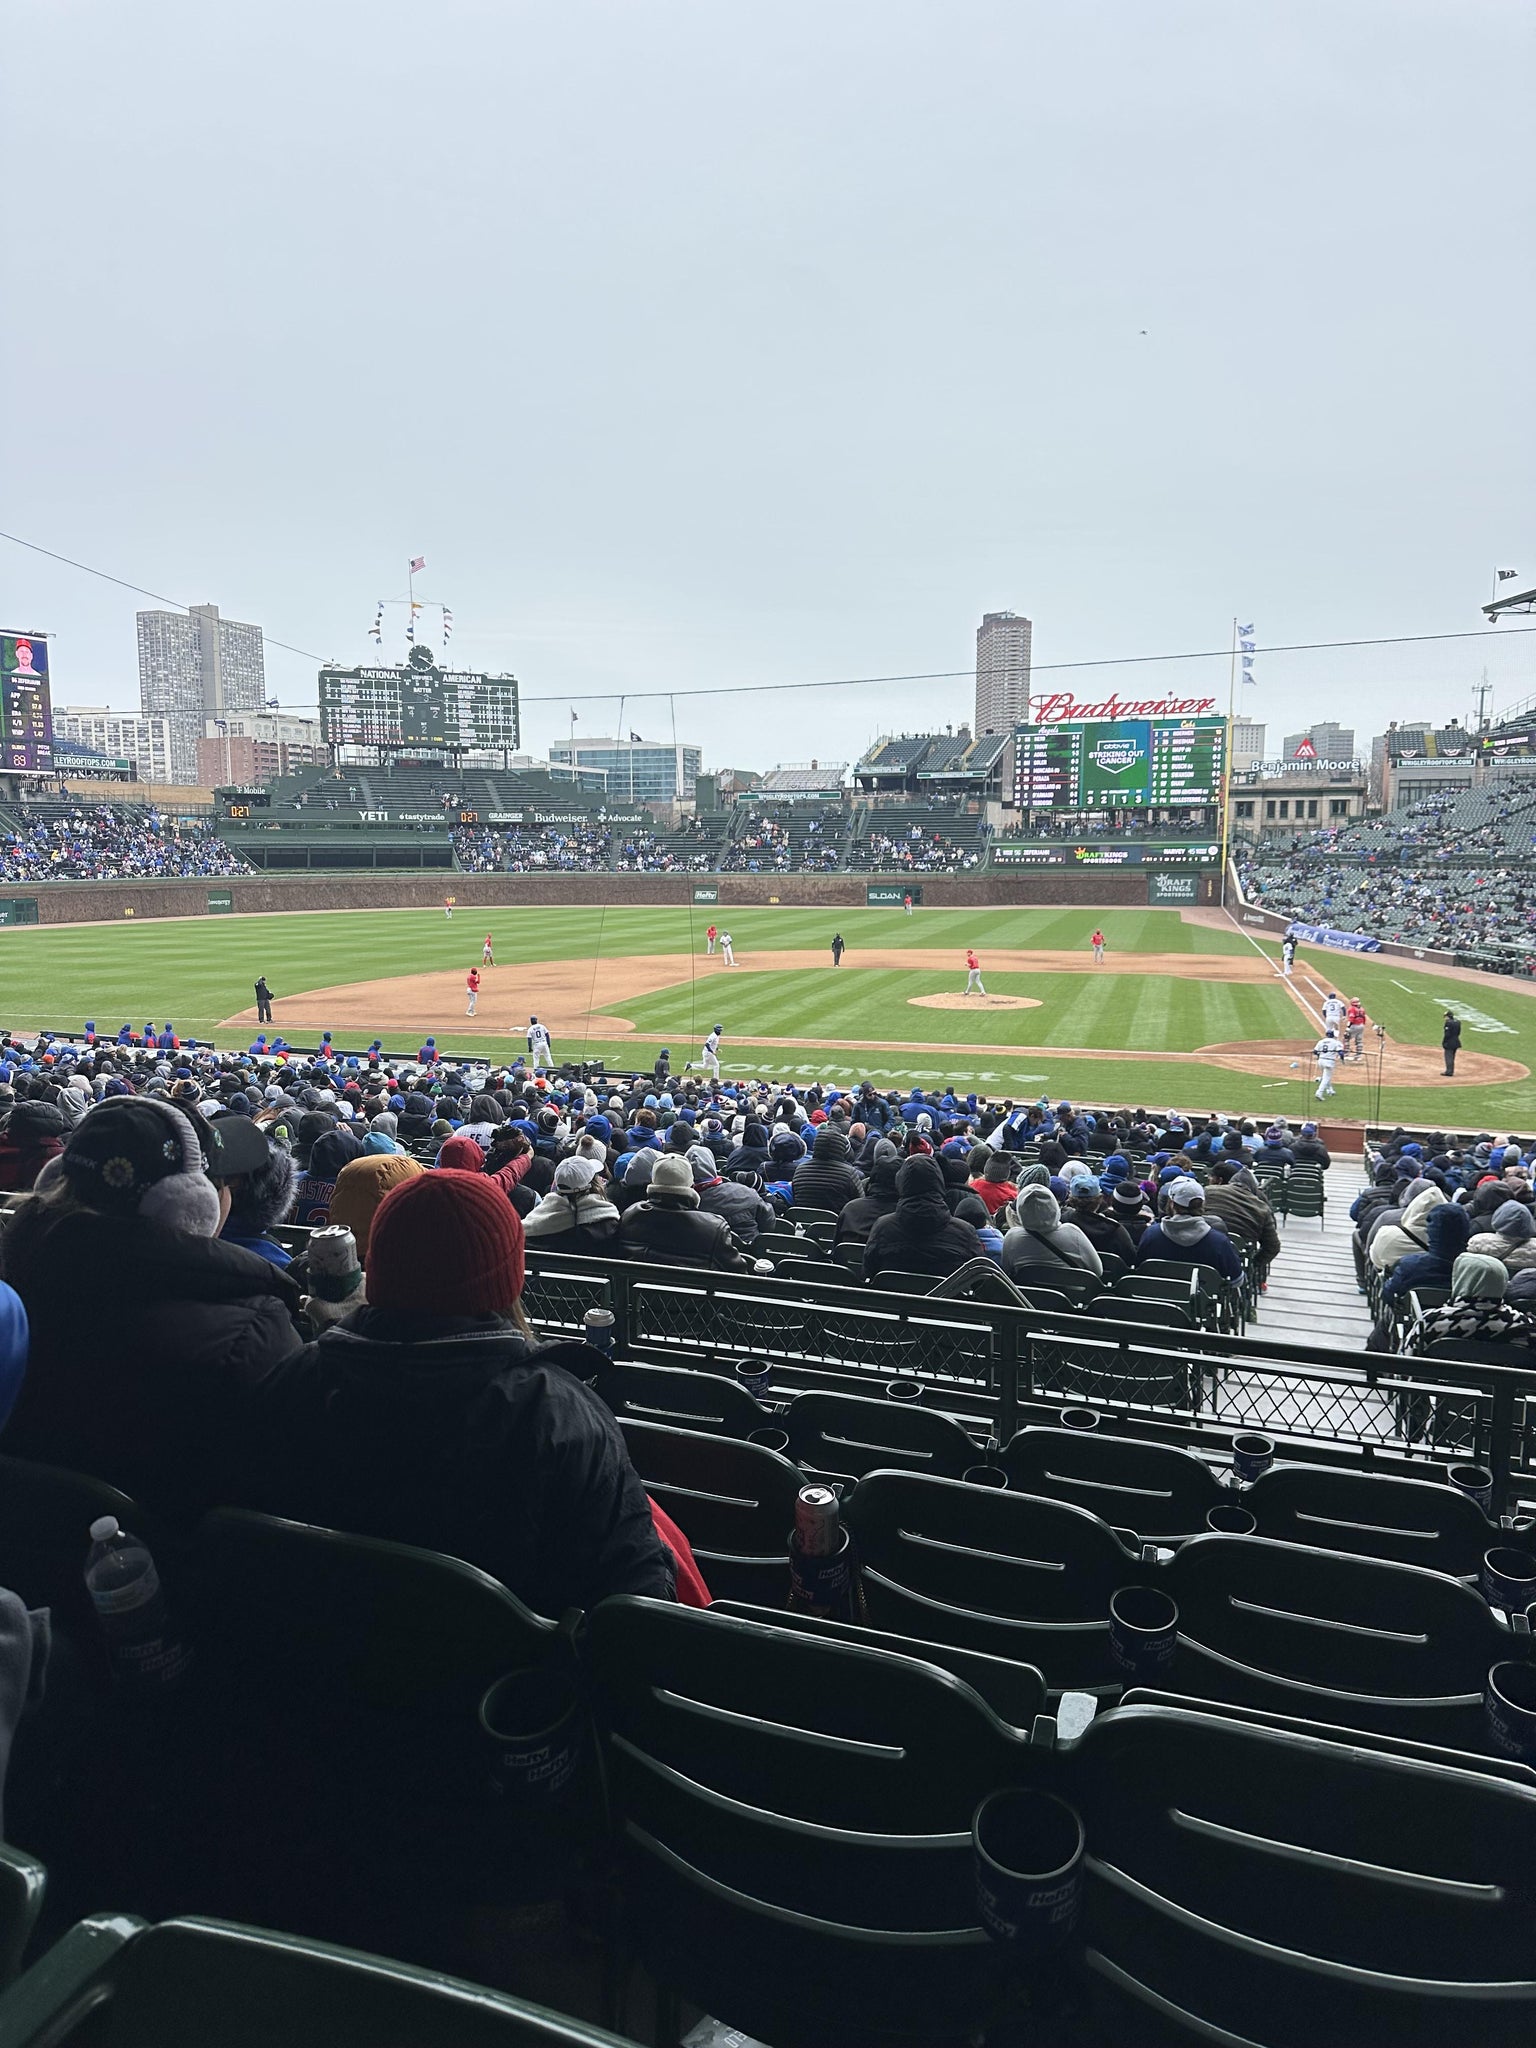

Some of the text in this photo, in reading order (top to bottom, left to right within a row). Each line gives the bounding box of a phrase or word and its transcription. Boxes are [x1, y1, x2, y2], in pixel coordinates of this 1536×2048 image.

[360, 670, 401, 680] NATIONAL
[442, 674, 482, 684] AMERICAN
[1028, 692, 1216, 723] Budweiser
[408, 710, 438, 718] 4 2
[1180, 720, 1196, 728] Cubs
[422, 726, 428, 734] 2
[1038, 726, 1058, 736] Angels
[1088, 750, 1144, 759] STRIKING OUT
[1251, 758, 1360, 773] Benjamin Moore
[244, 786, 266, 794] Mobile
[1087, 796, 1094, 804] 3
[1100, 795, 1108, 804] 2
[1135, 794, 1142, 804] 3
[231, 806, 250, 817] 0:27
[358, 812, 388, 821] YETI
[404, 813, 446, 821] tastytrade
[460, 812, 478, 822] 0:27
[1157, 879, 1192, 887] DRAFT
[696, 891, 717, 899] Hefty
[1330, 1004, 1335, 1012] 3
[536, 1030, 542, 1038] 0
[715, 1060, 1004, 1082] outhwest
[299, 1180, 336, 1204] ASTR
[1144, 1636, 1174, 1650] Hefty
[504, 1746, 550, 1766] Hefty
[1029, 1878, 1077, 1906] Hefty
